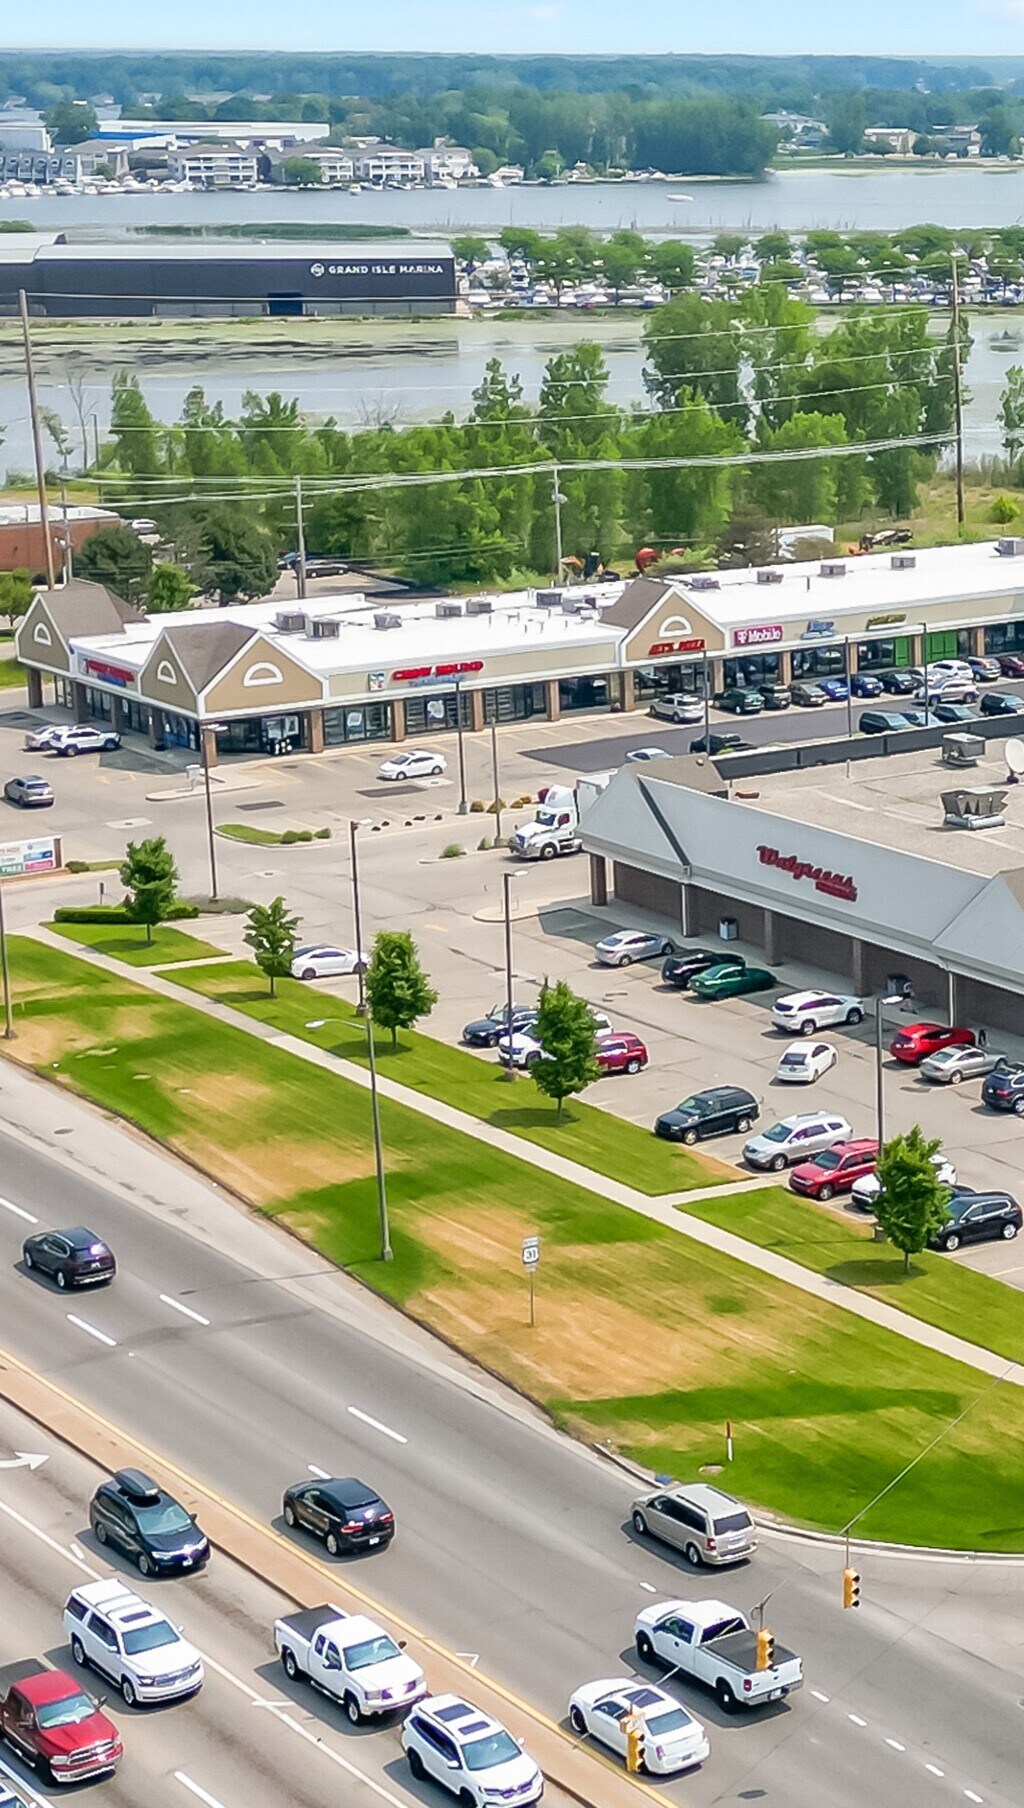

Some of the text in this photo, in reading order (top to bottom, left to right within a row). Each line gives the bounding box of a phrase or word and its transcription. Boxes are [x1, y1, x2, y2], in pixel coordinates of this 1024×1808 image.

[328, 265, 444, 274] GRAND ISLE MARINA
[756, 845, 858, 891] Walgreens
